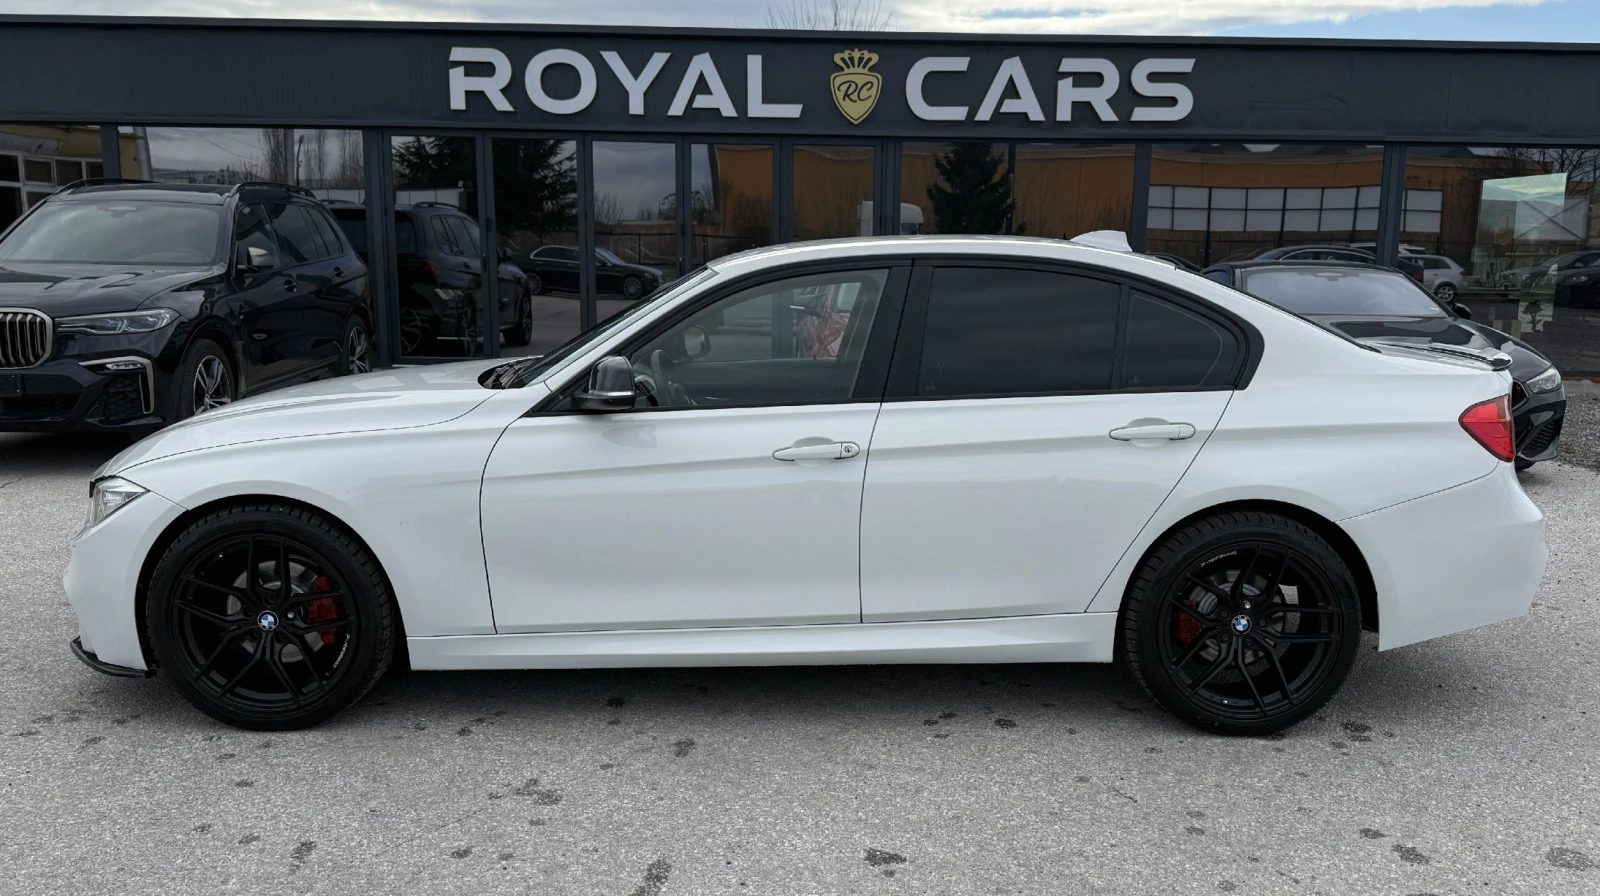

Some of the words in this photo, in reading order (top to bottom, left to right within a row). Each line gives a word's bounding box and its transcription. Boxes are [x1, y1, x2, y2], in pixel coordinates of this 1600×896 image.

[449, 46, 803, 118] ROYAL
[905, 55, 1196, 122] CARS
[837, 80, 874, 103] RC
